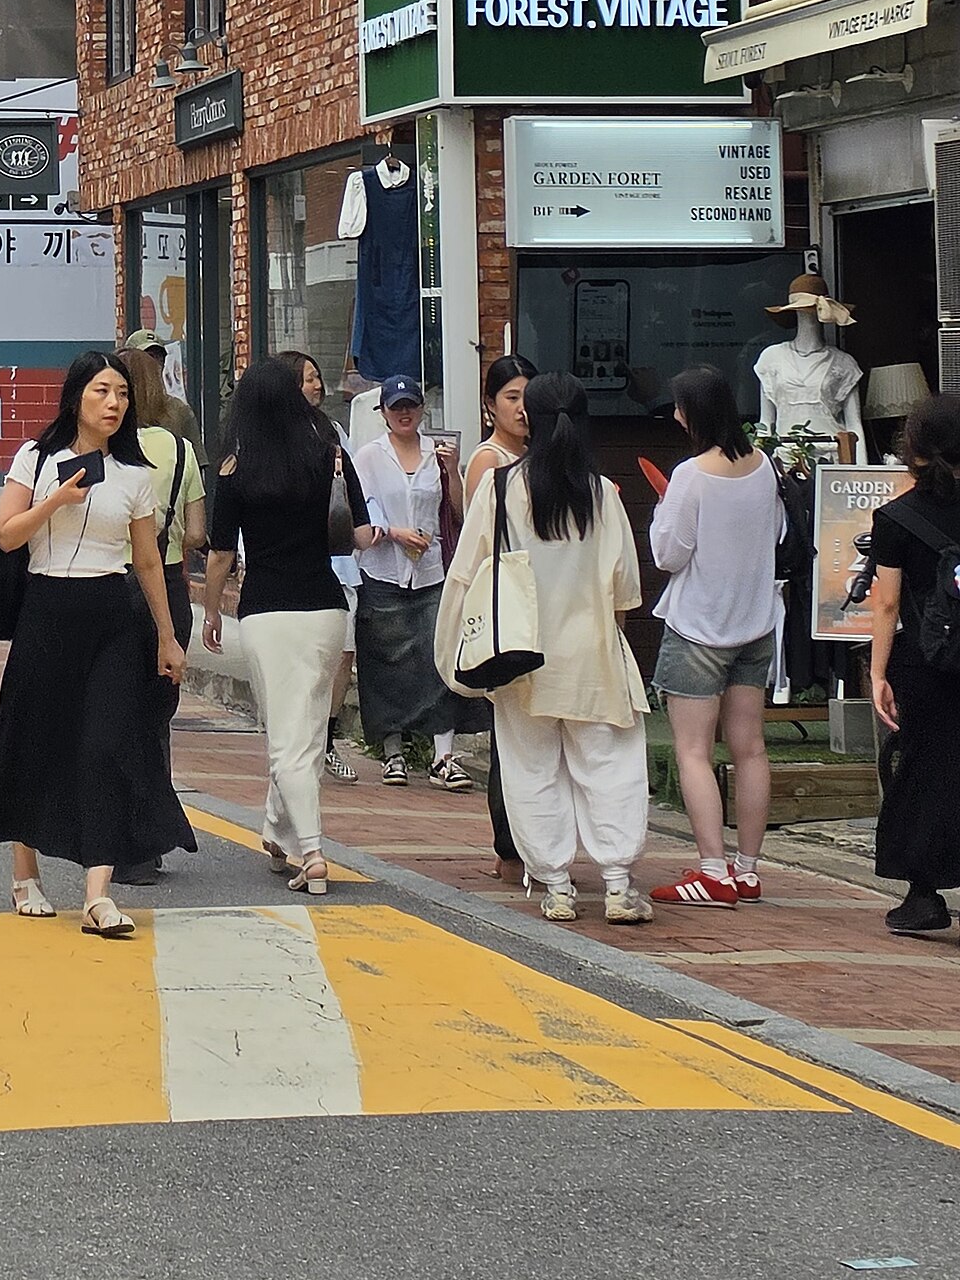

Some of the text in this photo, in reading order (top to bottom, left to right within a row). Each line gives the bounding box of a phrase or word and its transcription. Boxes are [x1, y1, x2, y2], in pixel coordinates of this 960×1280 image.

[828, 15, 859, 39] VINTAGE
[719, 145, 771, 159] VINTAGE
[533, 171, 661, 185] GARDEN FORET
[740, 166, 771, 180] USED
[725, 186, 771, 200] RESALE
[691, 207, 772, 221] SECOND HAND
[830, 481, 894, 495] GARDEN
